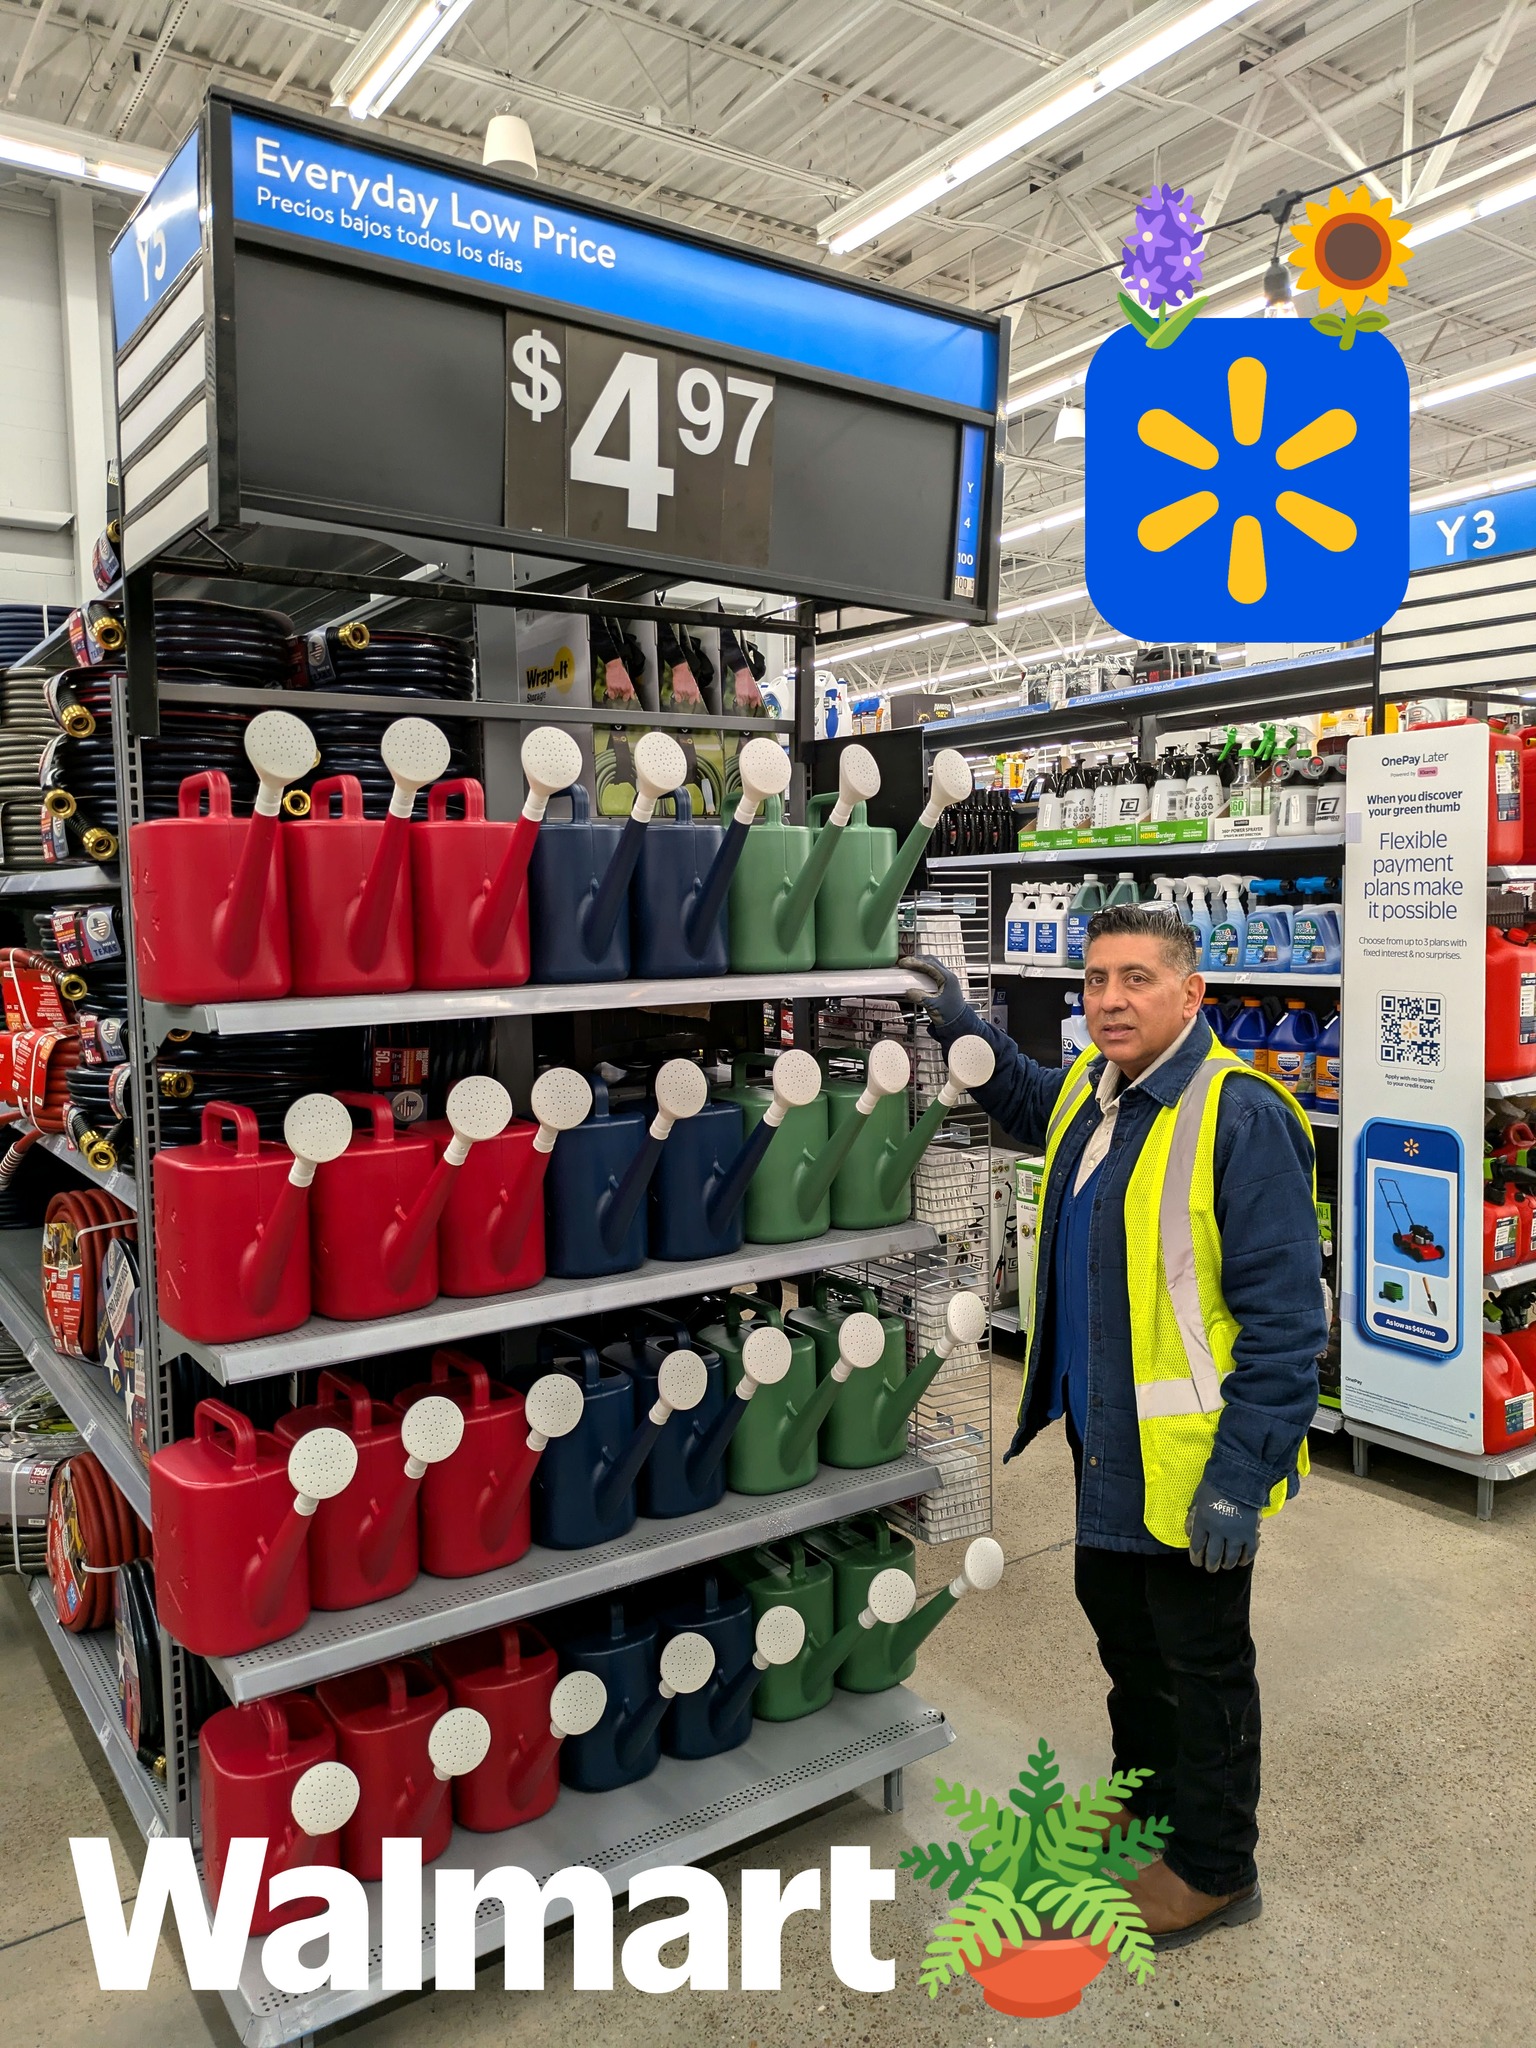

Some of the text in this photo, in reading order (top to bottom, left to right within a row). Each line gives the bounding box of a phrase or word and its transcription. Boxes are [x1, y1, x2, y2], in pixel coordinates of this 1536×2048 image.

[255, 136, 617, 270] Everyday Low Price
[257, 186, 523, 273] Precios bajos todos los días
[966, 482, 975, 494] Y
[963, 517, 971, 529] 4
[1436, 509, 1497, 556] Y3
[957, 552, 974, 566] 100
[526, 660, 568, 689] Wrap-It
[526, 691, 547, 703] Storage
[1381, 752, 1449, 767] OnePay Later
[1367, 790, 1463, 805] When you discover
[1368, 802, 1461, 818] your green thumb
[1380, 830, 1448, 850] Flexible
[1373, 854, 1454, 877] payment
[1364, 877, 1463, 899] plans make
[1369, 900, 1457, 922] it possible
[1359, 936, 1467, 948] Choose from up to 3 plans with
[93, 944, 118, 957] TEXAS
[1363, 949, 1381, 957] fixed
[1381, 949, 1408, 958] interest
[1408, 950, 1414, 958] &
[1426, 951, 1462, 960] surprises.
[63, 953, 75, 967] 50
[85, 1050, 93, 1062] 50
[375, 1050, 391, 1063] 50
[994, 1292, 1000, 1301] 2
[1394, 1320, 1404, 1328] low
[1405, 1323, 1412, 1331] as
[1412, 1325, 1436, 1337] $45/mo
[1345, 1376, 1362, 1386] OnePay
[1213, 1502, 1235, 1514] XPERT
